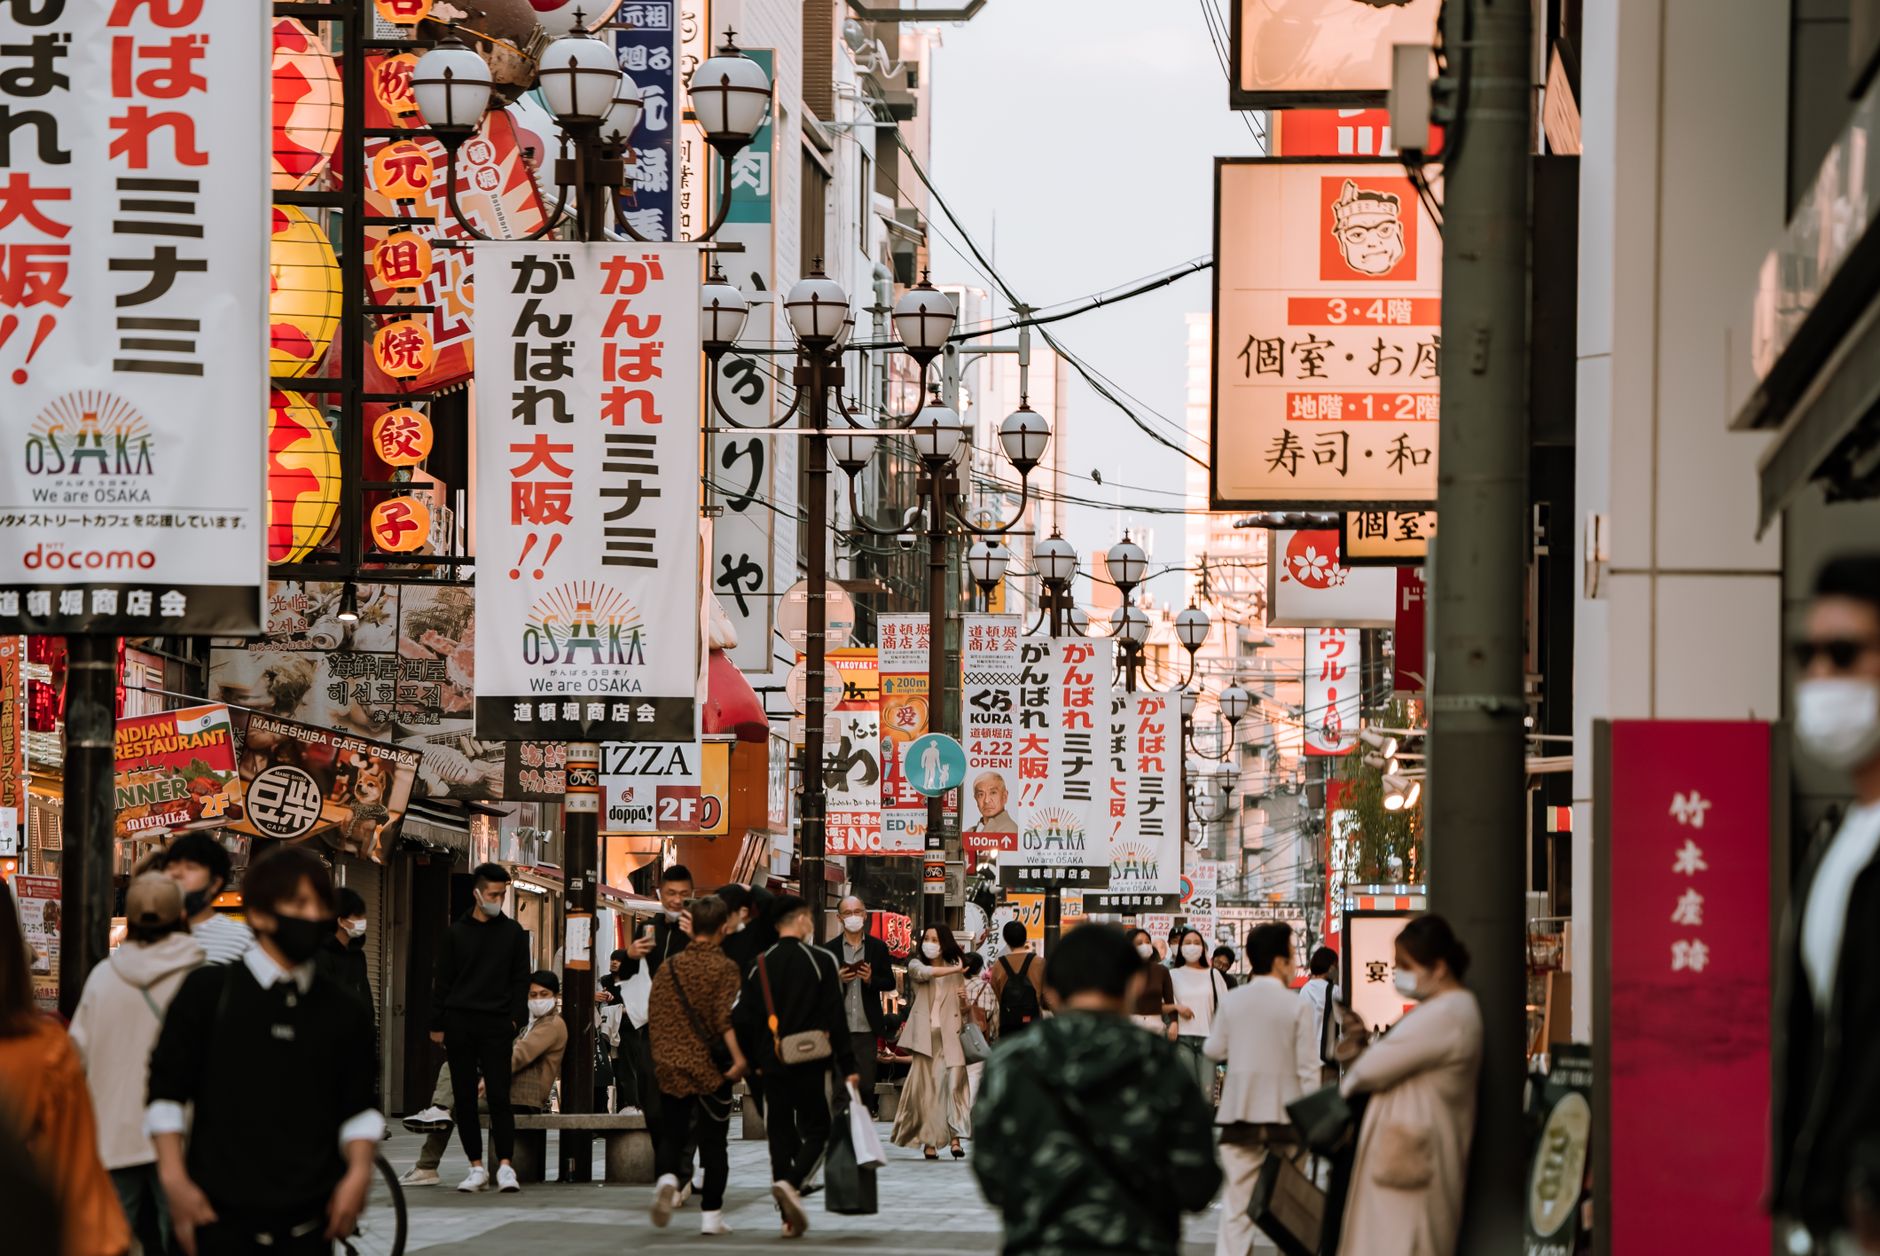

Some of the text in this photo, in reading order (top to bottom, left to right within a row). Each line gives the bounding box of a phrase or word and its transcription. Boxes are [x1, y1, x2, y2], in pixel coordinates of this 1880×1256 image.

[509, 254, 576, 580] がんばれ大阪!!
[600, 254, 664, 568] がんばれミナミ
[25, 412, 155, 476] OSAKA
[32, 488, 151, 503] We are OSAKA
[23, 543, 156, 570] docomo
[523, 600, 646, 666] OSAKA
[836, 661, 873, 670] TAKOYAKI
[530, 678, 642, 693] We are OSAKA
[896, 677, 927, 688] 200m
[969, 689, 1012, 712] くら
[513, 702, 656, 723] 道頓堀商店会
[970, 713, 1012, 724] KURA
[1061, 643, 1094, 801] がんばれミナミ
[251, 716, 415, 767] MAMESHIBA CAFE OSAKA
[969, 741, 1013, 756] 4.22
[969, 757, 1013, 768] OPEN!
[1137, 697, 1166, 836] がんばれミナミ
[200, 793, 229, 819] 2F
[609, 805, 653, 824] doppa!
[659, 797, 697, 822] 2F
[266, 823, 288, 832] CAFE
[1023, 818, 1085, 850] OSAKA
[968, 836, 998, 847] 100m
[1026, 856, 1039, 864] We
[1055, 856, 1084, 864] OSAKA
